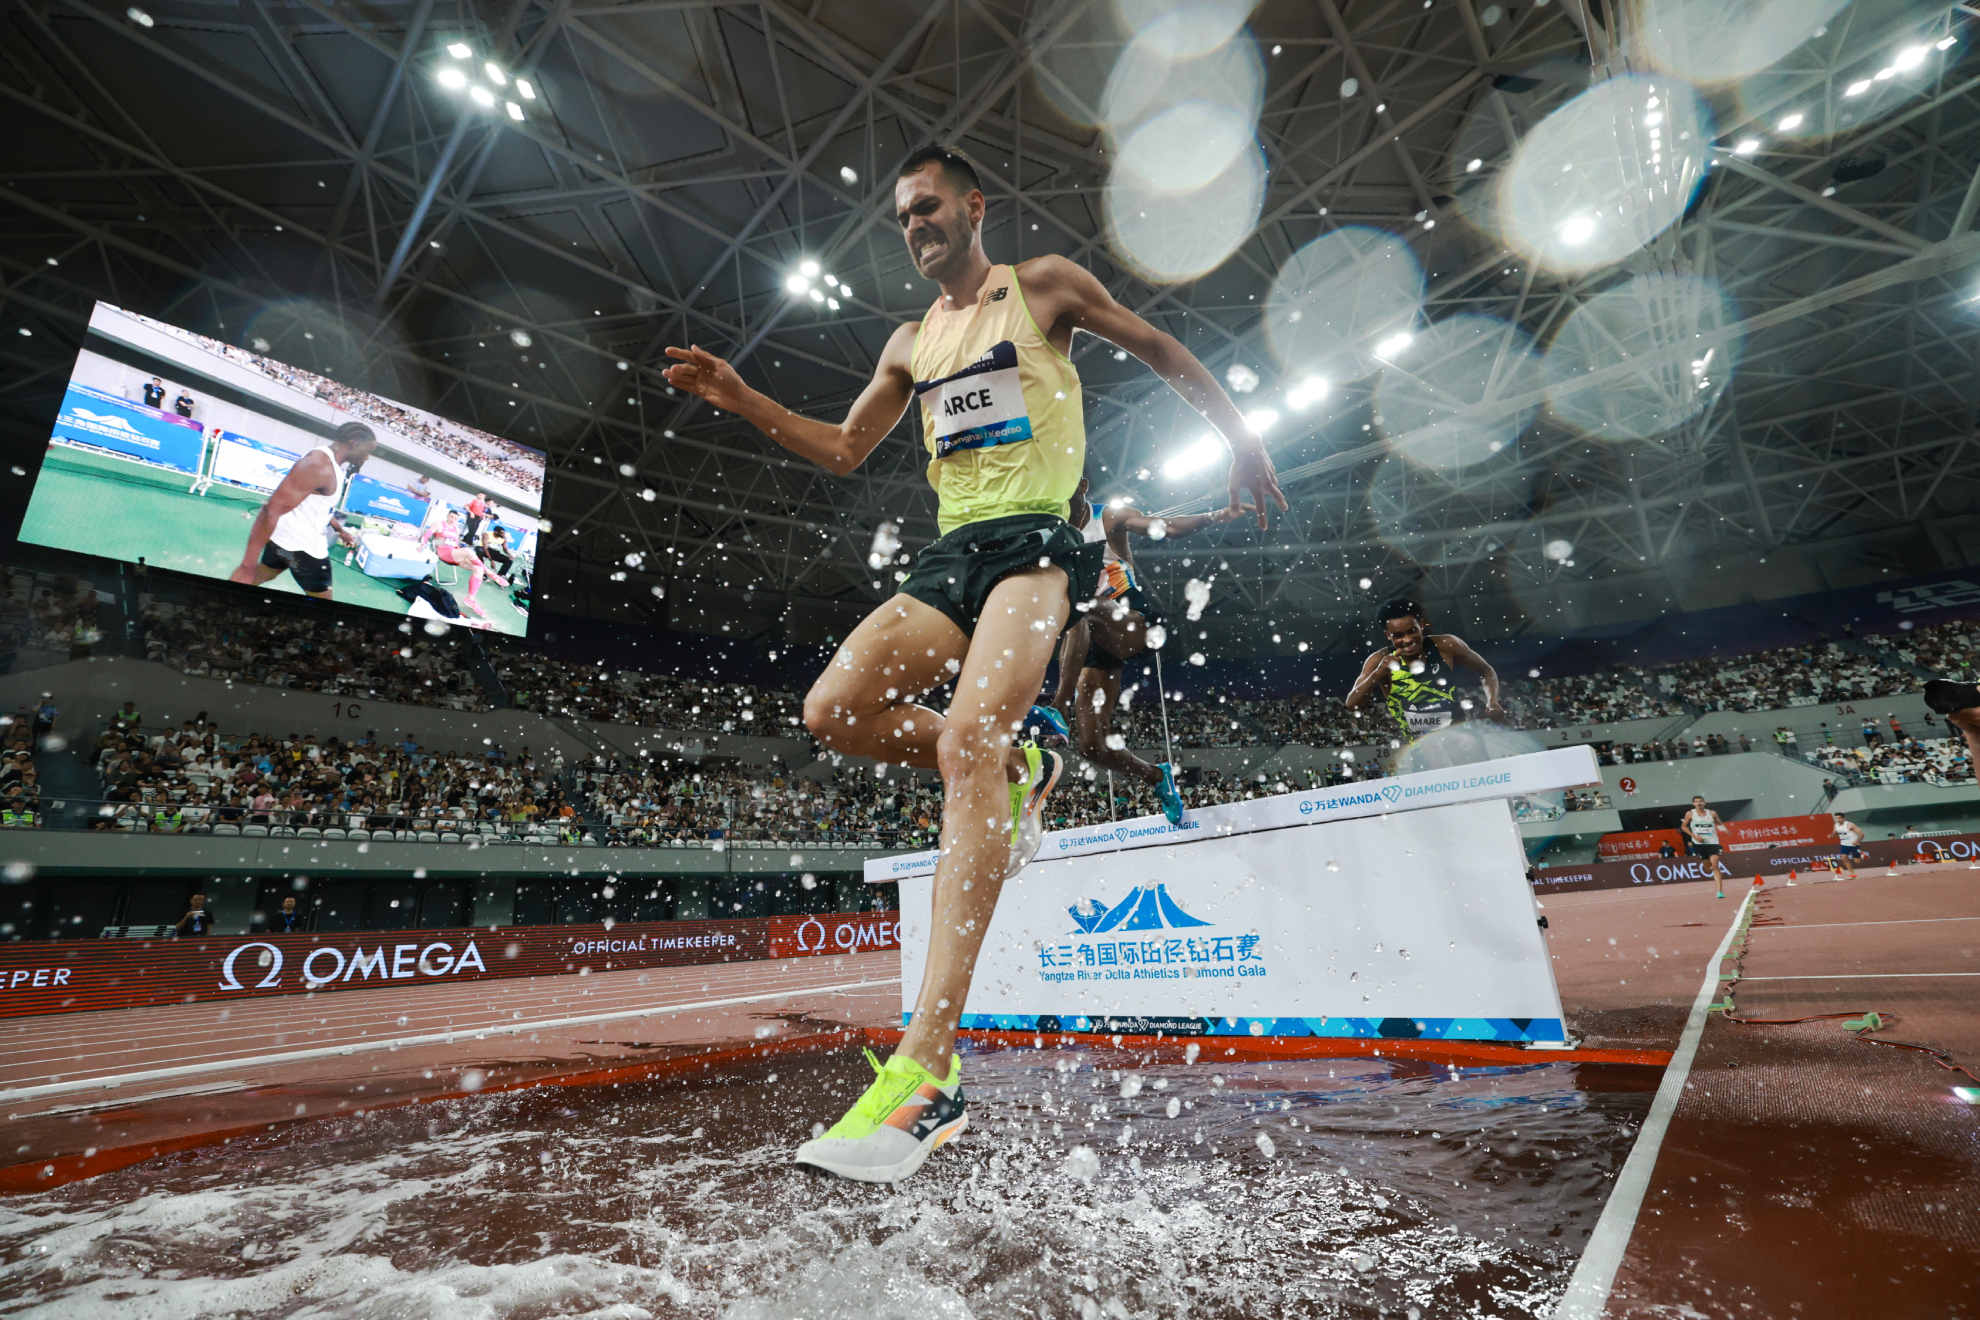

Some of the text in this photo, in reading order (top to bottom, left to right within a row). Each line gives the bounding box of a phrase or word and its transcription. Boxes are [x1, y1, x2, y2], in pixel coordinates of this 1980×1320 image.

[944, 388, 993, 418] ARCE
[944, 432, 984, 450] Shanghai
[988, 425, 1022, 441] Keqiao
[332, 701, 362, 719] 1C
[1835, 705, 1856, 716] 3A
[1409, 717, 1441, 726] AMARE
[1404, 772, 1512, 797] DIAMOND LEAGUE
[1624, 779, 1633, 791] 2
[1129, 820, 1200, 838] DIAMOND LEAGUE
[1770, 856, 1811, 866] OFFICIAL
[1545, 873, 1593, 884] TIMEKEEPER
[573, 934, 736, 955] OFFICIAL TIMEKEEPER
[1038, 934, 1263, 968] 长三角国际田径钻石赛
[302, 940, 487, 984] OMEGA
[1038, 970, 1075, 984] Yangtze
[1104, 968, 1131, 980] Delta
[1133, 967, 1180, 979] Athletics
[1237, 964, 1267, 977] Gala
[1149, 1022, 1202, 1030] DIAMOND LEAGUE
